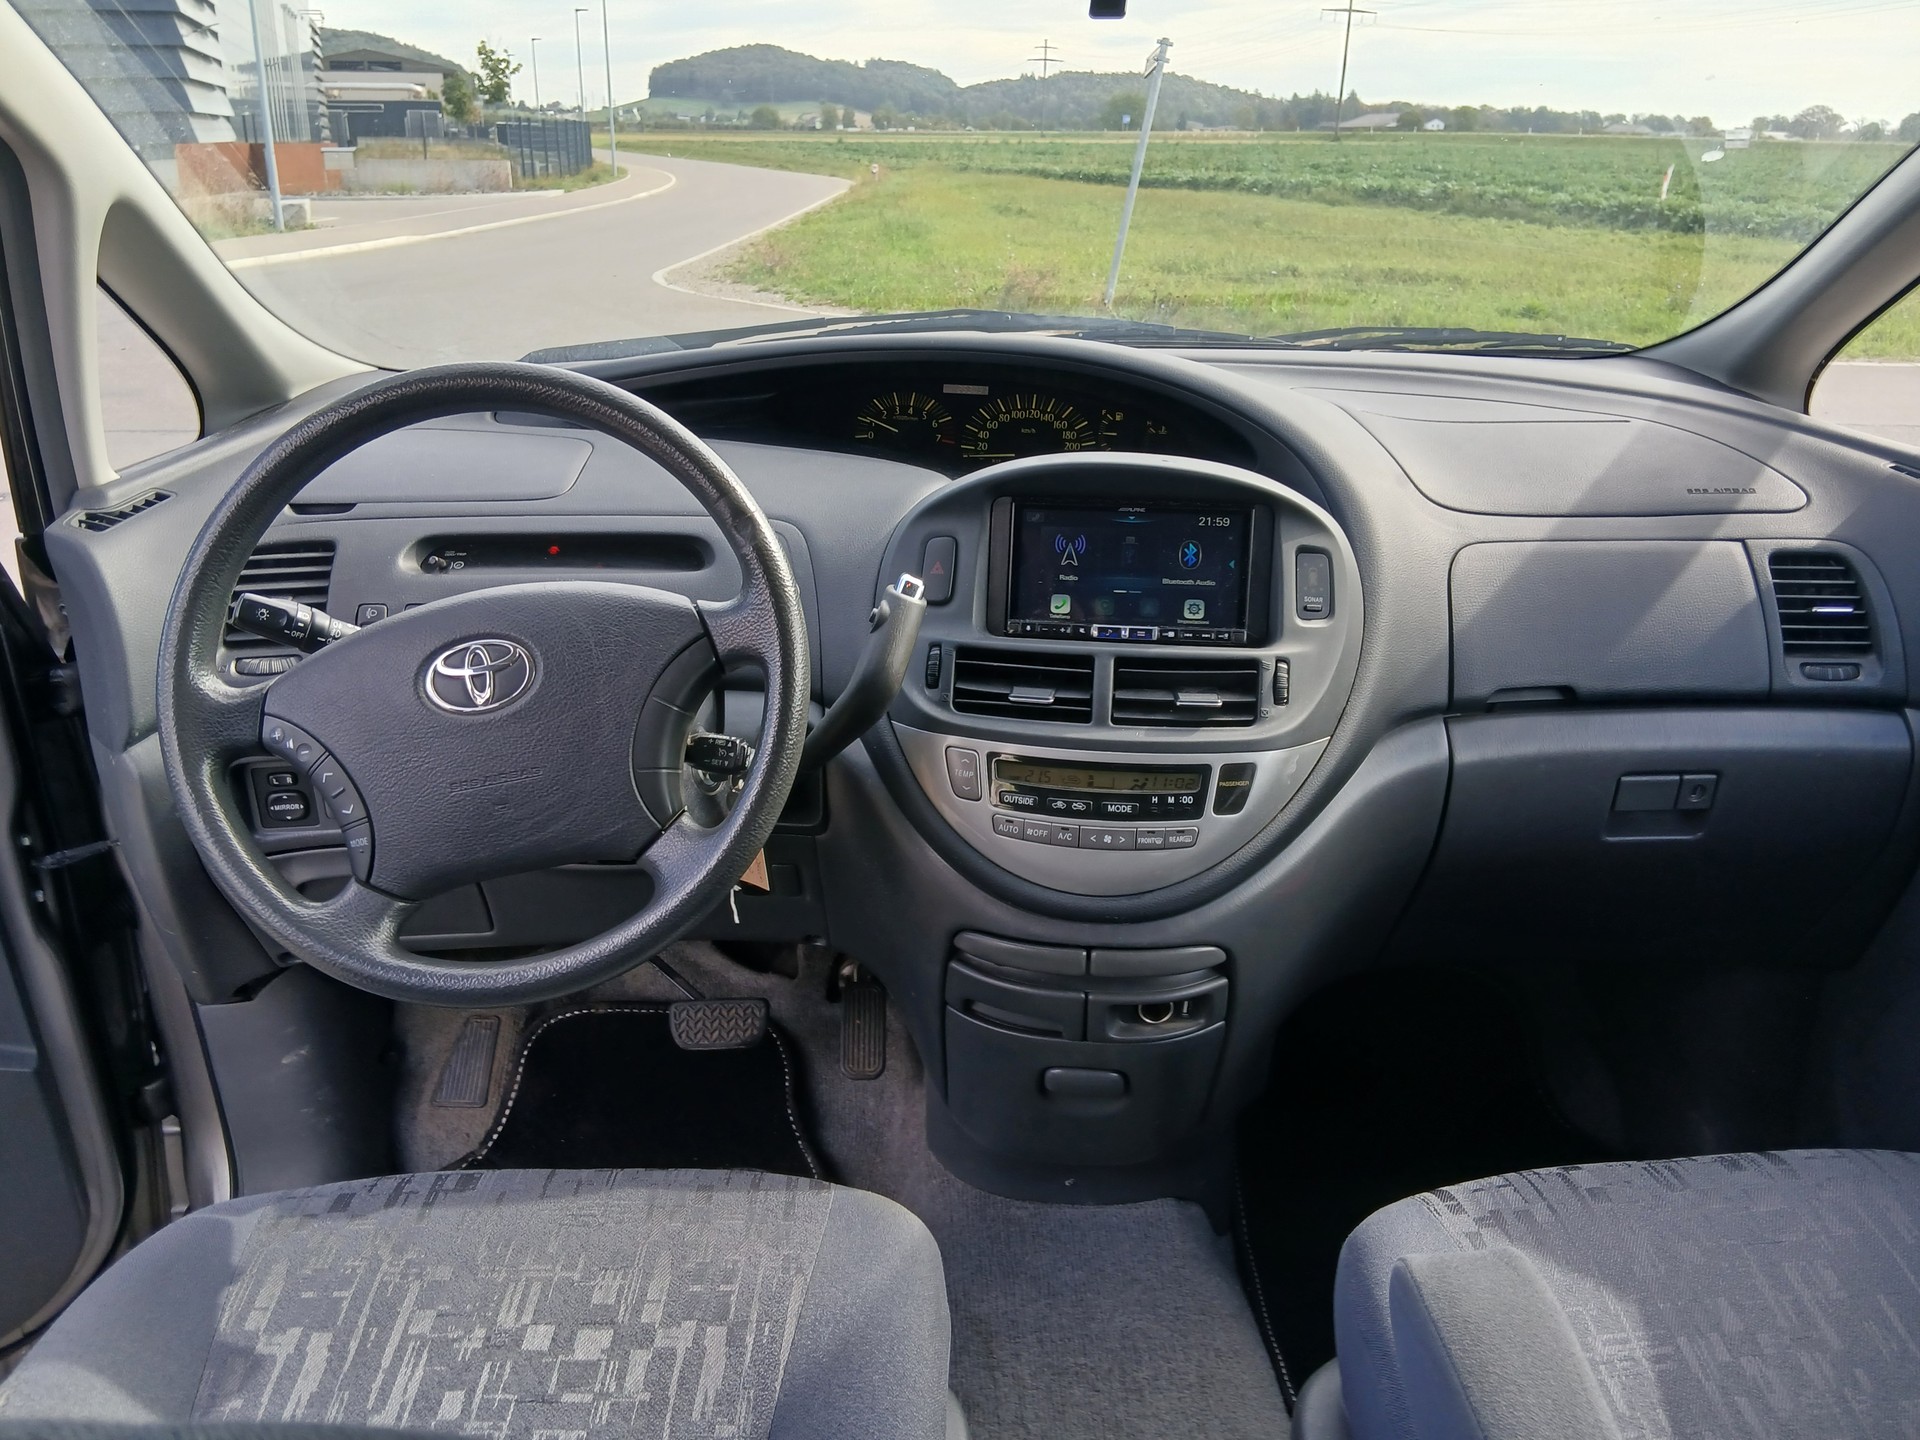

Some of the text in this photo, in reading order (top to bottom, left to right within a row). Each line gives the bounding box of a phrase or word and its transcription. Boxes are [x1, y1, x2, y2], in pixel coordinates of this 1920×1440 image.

[882, 411, 887, 419] 2
[895, 407, 900, 415] 3
[908, 407, 913, 415] 4
[922, 411, 927, 420] 5
[932, 419, 938, 428] 6
[936, 434, 941, 442] 7
[977, 410, 1080, 451] 20 40 60 80 100 120 140 160 180 200
[1199, 517, 1230, 526] 21:59
[291, 630, 305, 639] OFF
[955, 769, 974, 778] TEMP
[1153, 777, 1195, 789] 11:02
[1004, 795, 1034, 805] OUTSIDE
[1107, 805, 1132, 813] MODE
[999, 824, 1018, 834] AUTO
[1033, 829, 1048, 838] OFF
[1058, 833, 1072, 841] A/C
[350, 837, 368, 847] MODE
